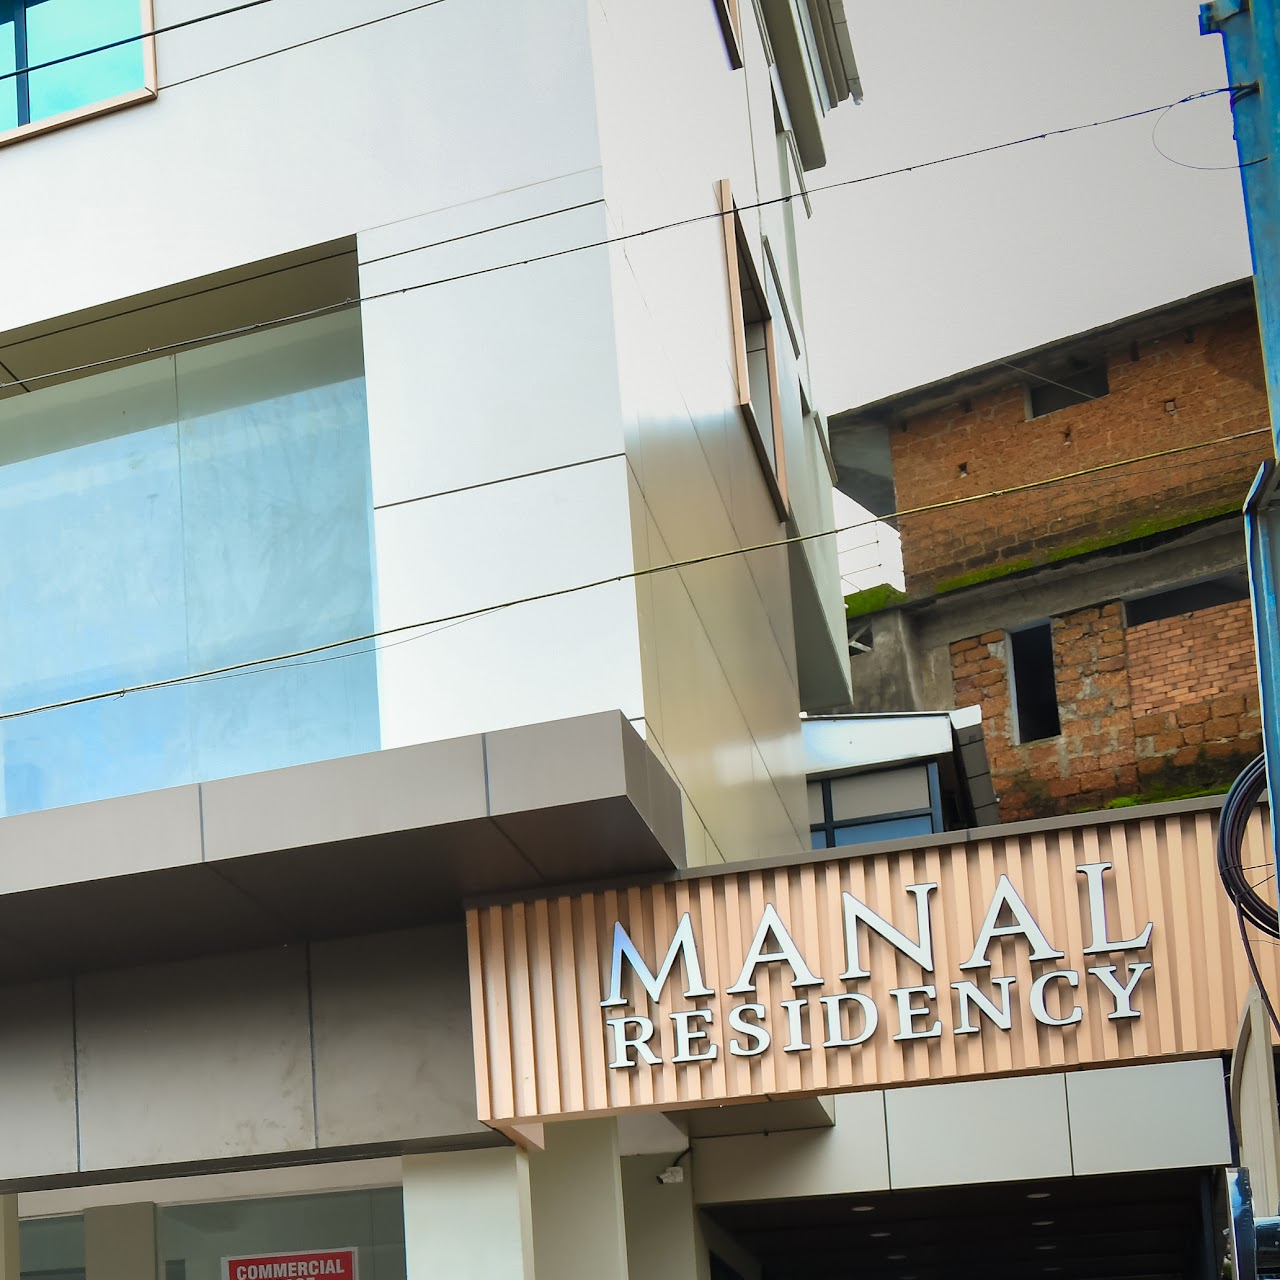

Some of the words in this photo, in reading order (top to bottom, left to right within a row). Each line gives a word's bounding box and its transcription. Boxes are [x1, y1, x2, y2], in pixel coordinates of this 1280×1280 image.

[600, 862, 1154, 1009] MANAL
[606, 961, 1153, 1071] RESIDENCY
[236, 1259, 345, 1280] COMMERCIAL
